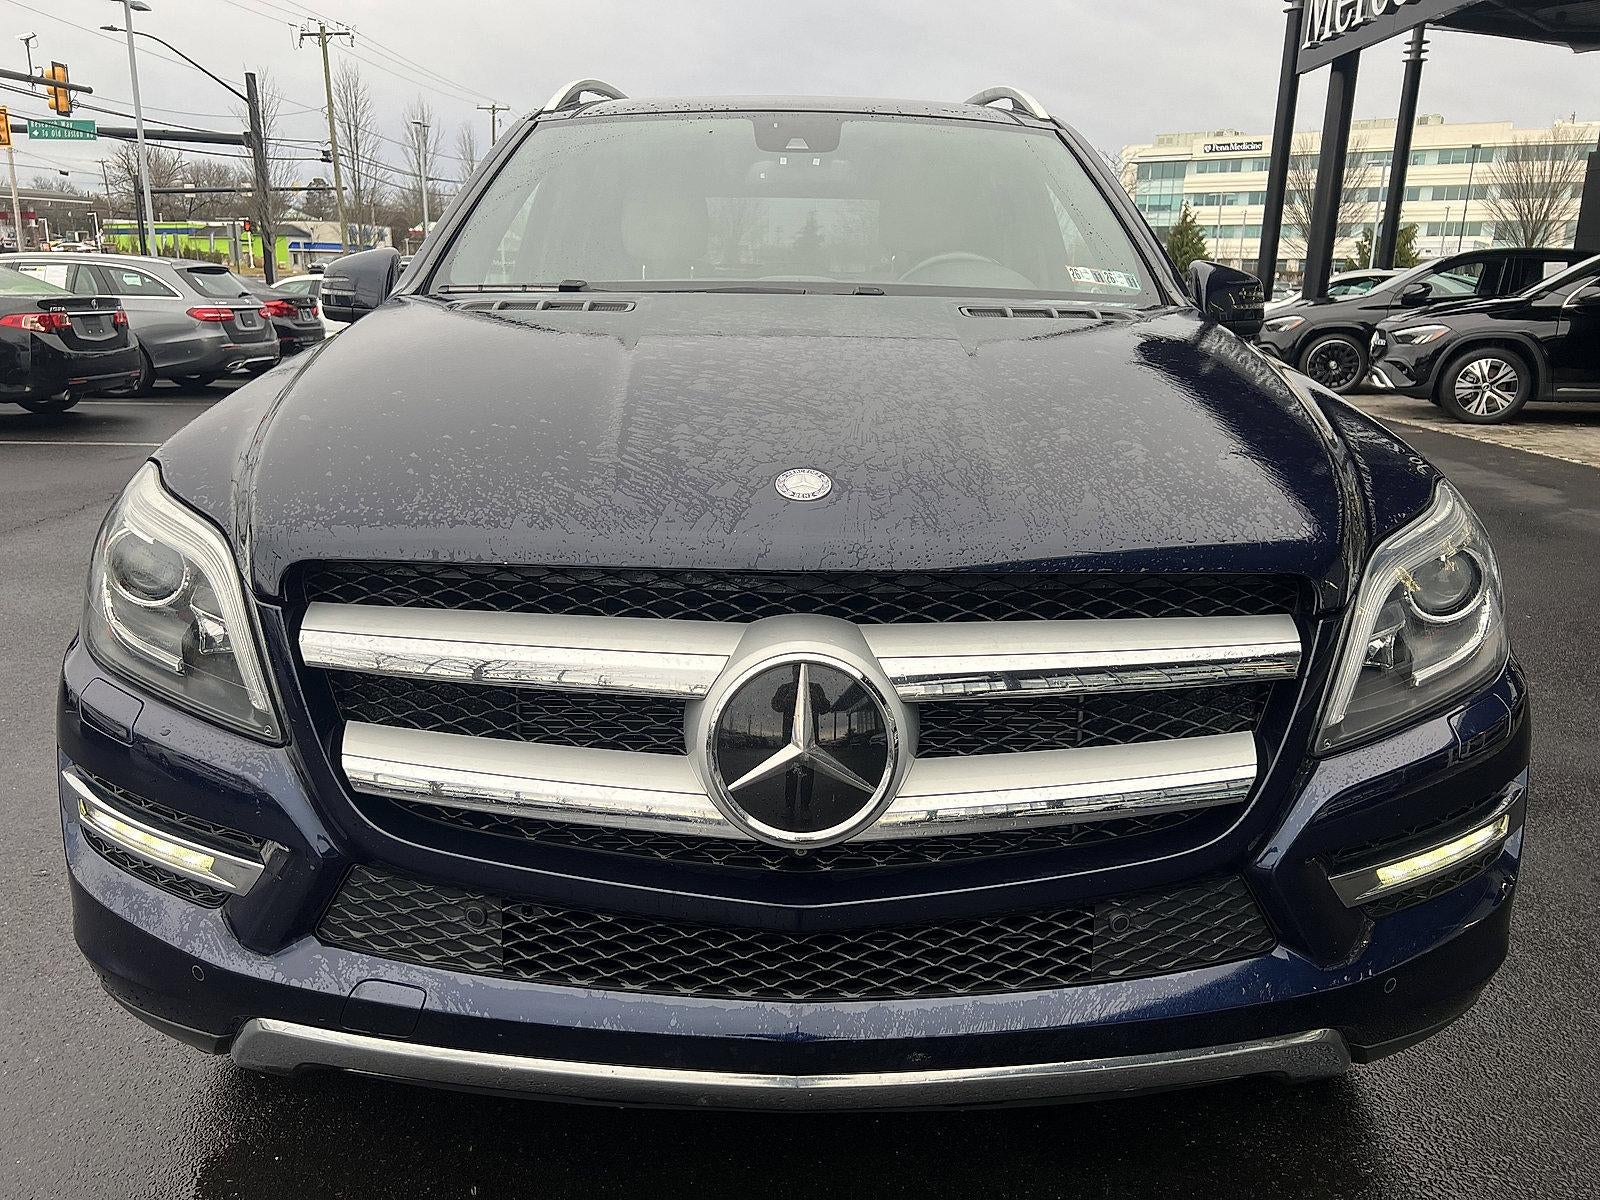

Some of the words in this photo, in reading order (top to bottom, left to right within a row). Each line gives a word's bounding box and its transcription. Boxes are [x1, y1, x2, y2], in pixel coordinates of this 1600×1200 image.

[61, 121, 73, 129] Way
[42, 129, 49, 138] To
[51, 129, 62, 138] Old
[1212, 143, 1230, 152] Penn
[1230, 141, 1263, 151] Medicine
